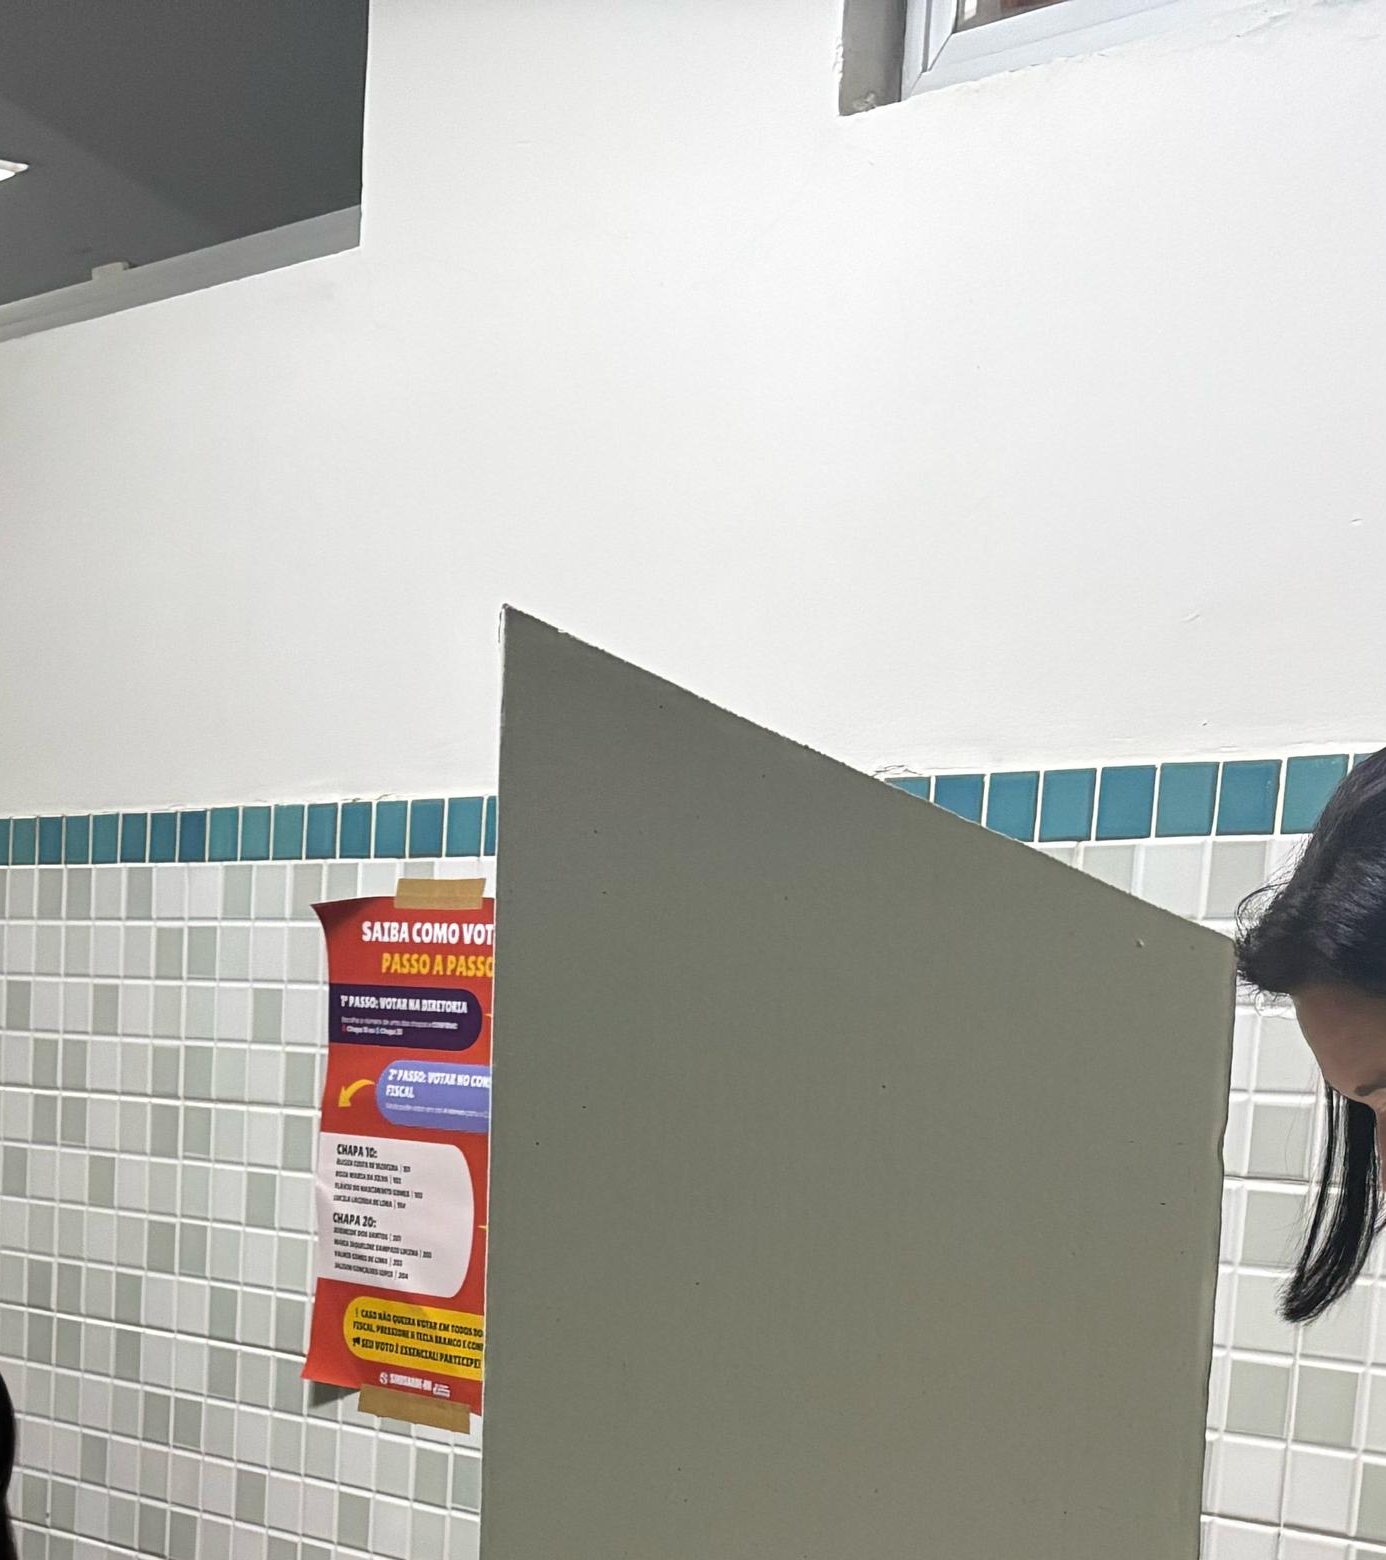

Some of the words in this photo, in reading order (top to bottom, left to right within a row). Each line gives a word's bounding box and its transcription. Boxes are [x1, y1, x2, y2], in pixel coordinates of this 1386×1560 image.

[362, 921, 409, 942] SAIBA
[412, 922, 460, 945] COMO
[462, 923, 494, 945] VOT
[381, 953, 430, 975] PASSO
[432, 954, 444, 975] A
[446, 955, 494, 978] PASSO
[348, 996, 379, 1009] PASSO:
[379, 997, 408, 1010] VOTAR
[421, 999, 468, 1013] DIRETORIA
[427, 1072, 456, 1085] VOTAR
[386, 1084, 415, 1098] FISCAL
[336, 1143, 364, 1157] CHAPA
[333, 1212, 361, 1227] CHAPA
[362, 1215, 377, 1228] 20:
[438, 1322, 450, 1332] EM
[375, 1340, 394, 1353] VOTO
